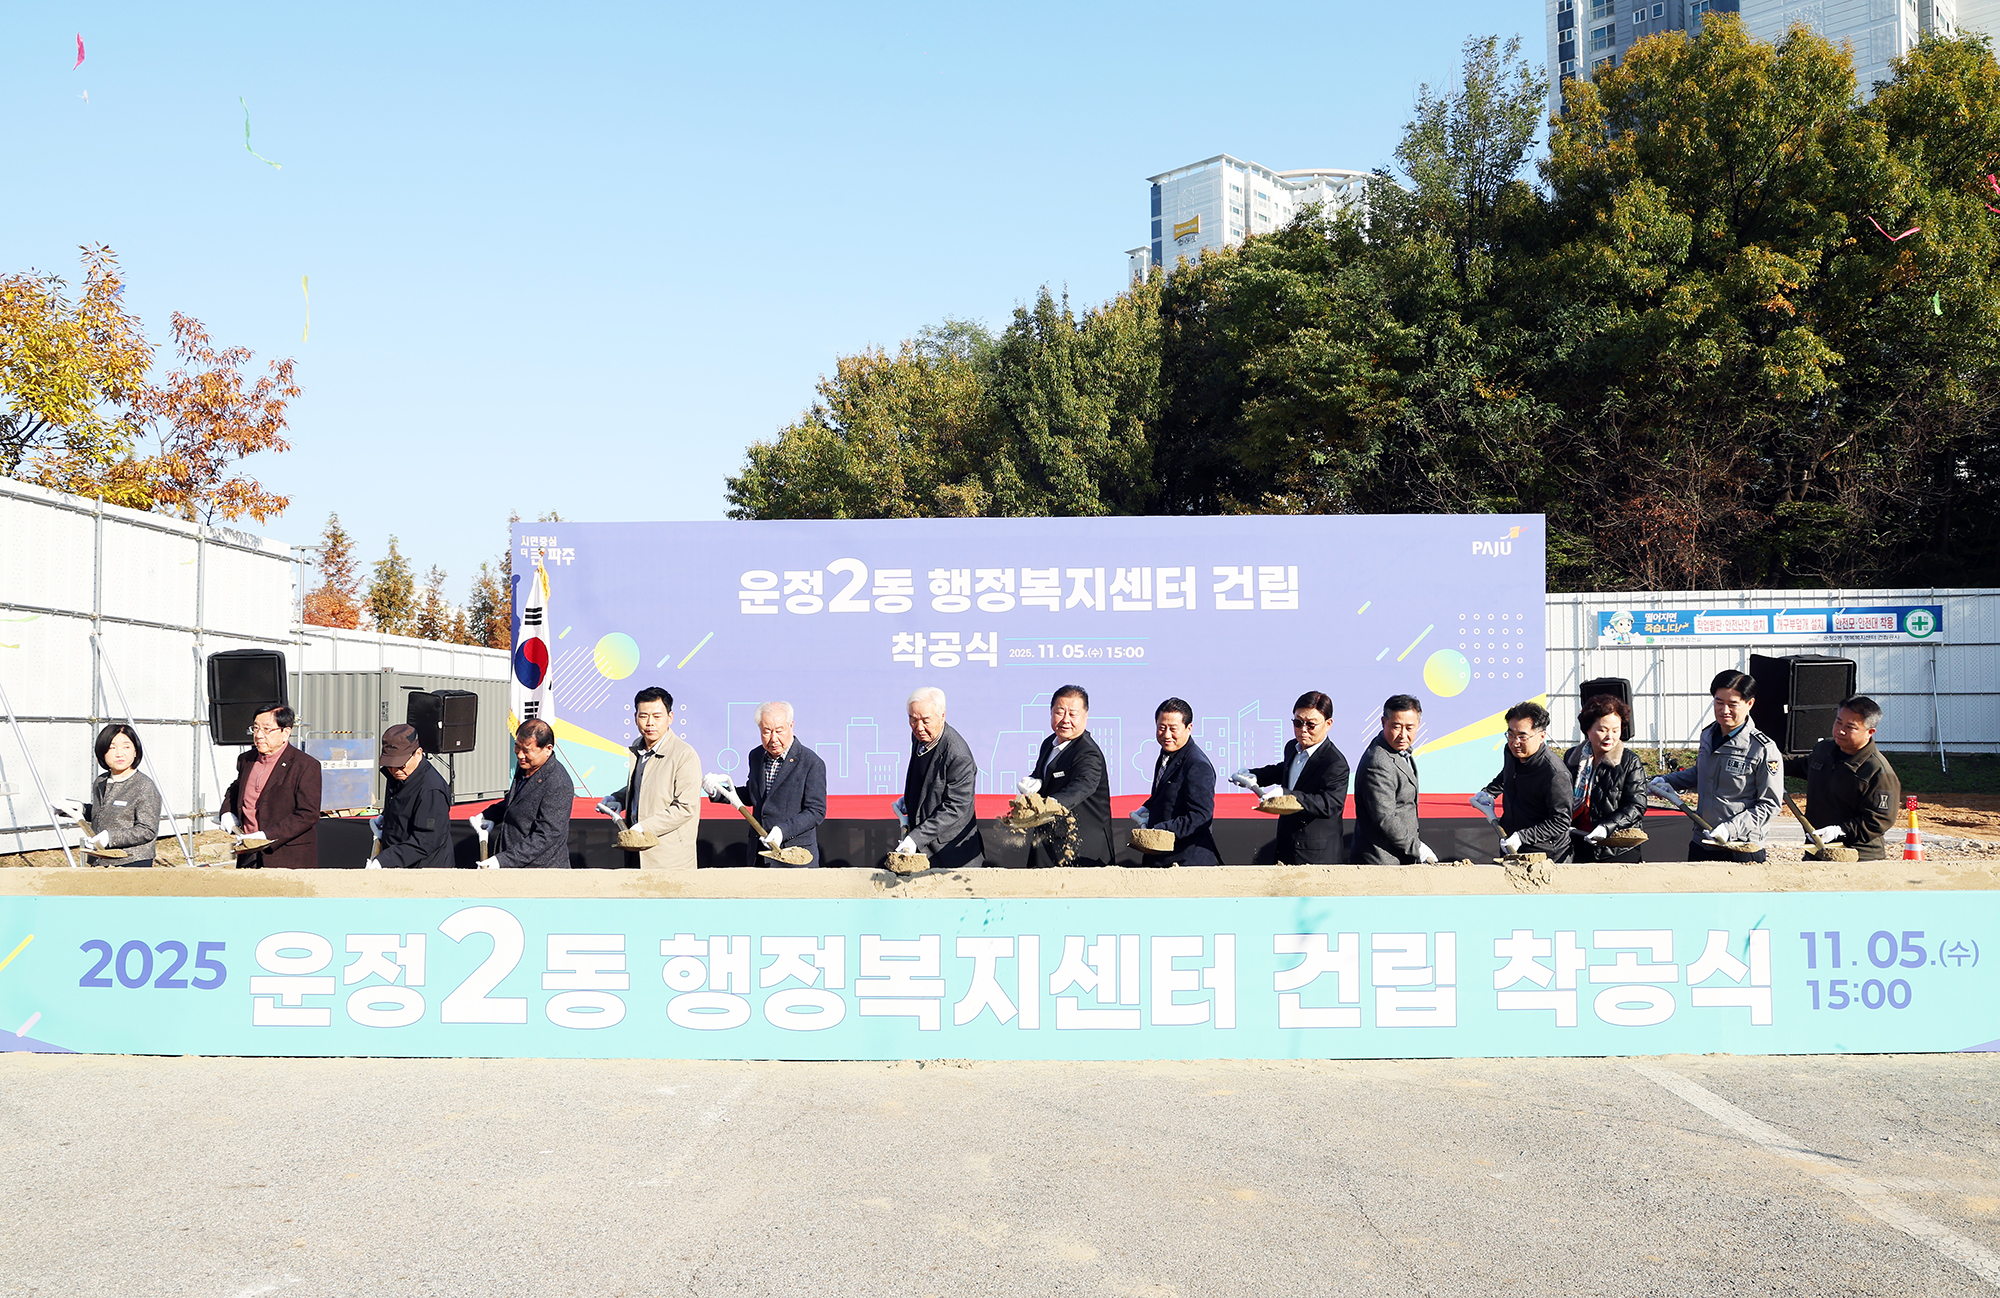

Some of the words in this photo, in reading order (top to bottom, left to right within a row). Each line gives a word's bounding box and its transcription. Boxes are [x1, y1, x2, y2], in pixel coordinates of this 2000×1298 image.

[520, 535, 557, 547] 시민중심
[1472, 541, 1512, 558] PAJU
[520, 548, 528, 559] 더
[547, 548, 576, 566] 파주
[738, 557, 914, 615] 운정2동
[928, 566, 1197, 613] 행정복지센터
[1212, 565, 1299, 610] 건립
[1645, 612, 1678, 623] 떨어지면
[1752, 619, 1766, 631] 설치
[1811, 618, 1824, 631] 설치
[1880, 616, 1894, 630] 착용
[891, 631, 998, 668] 착공식
[1009, 648, 1034, 658] 2025.
[1106, 646, 1145, 659] 15:00
[78, 939, 228, 991] 2025
[248, 905, 631, 1030] 운정2동
[659, 932, 1237, 1032] 행정복지센터
[1272, 930, 1458, 1029] 건립
[1492, 927, 1774, 1028] 착공식
[1806, 978, 1912, 1010] 15:00
